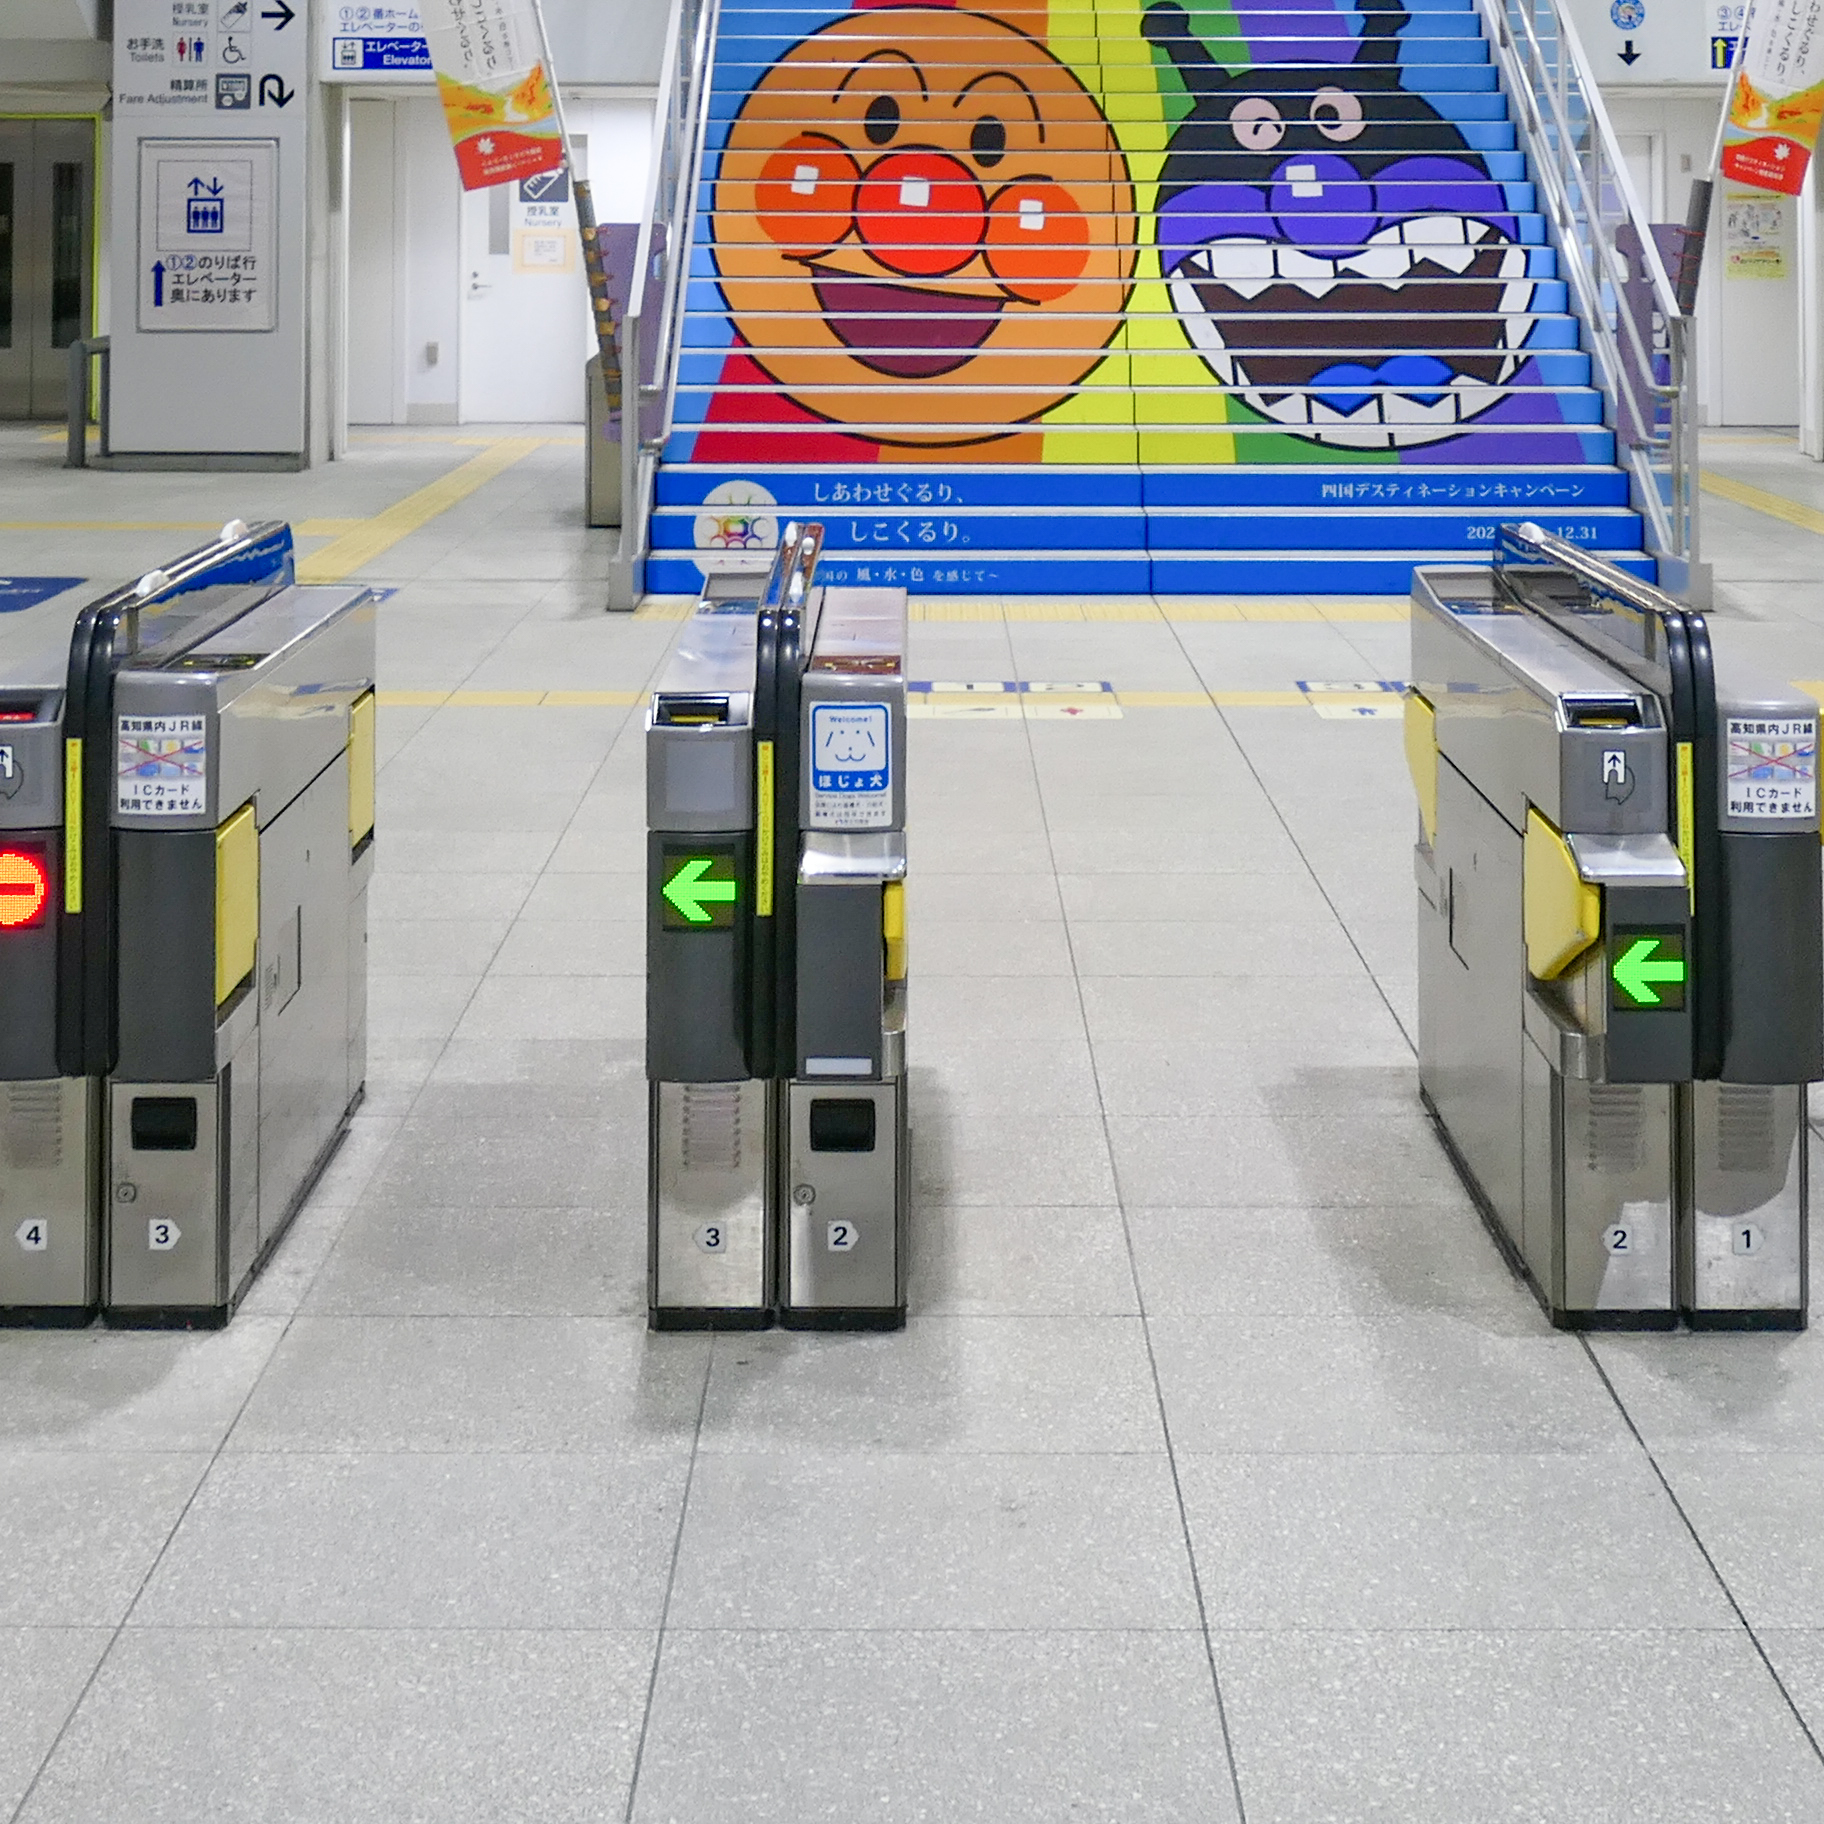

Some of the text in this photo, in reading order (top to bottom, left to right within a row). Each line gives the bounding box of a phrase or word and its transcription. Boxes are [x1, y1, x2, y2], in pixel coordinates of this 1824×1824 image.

[172, 3, 209, 15] 授乳室
[172, 17, 209, 27] Nursery
[126, 38, 165, 51] お手洗
[130, 52, 165, 62] Toilets
[383, 54, 433, 66] Elevator
[170, 79, 208, 91] 精算所
[119, 94, 208, 105] Fare Adjustment
[171, 272, 256, 286] エレベーター
[170, 288, 256, 304] 奥にあります
[814, 482, 963, 504] しあわせぐるり、
[1321, 483, 1585, 498] 四国デスティネーションキャンペーン
[851, 521, 971, 543] しこくるり。
[819, 773, 883, 788] ほじょ犬
[134, 784, 189, 796] ICカード
[1746, 787, 1801, 798] ICカード
[120, 798, 202, 810] 利用できません
[1730, 801, 1812, 813] 利用できません
[26, 1226, 42, 1244] 4
[155, 1226, 170, 1245] 3
[705, 1227, 720, 1247] 3
[833, 1226, 848, 1246] 2
[1613, 1230, 1627, 1249] 2
[1742, 1230, 1751, 1249] 1
